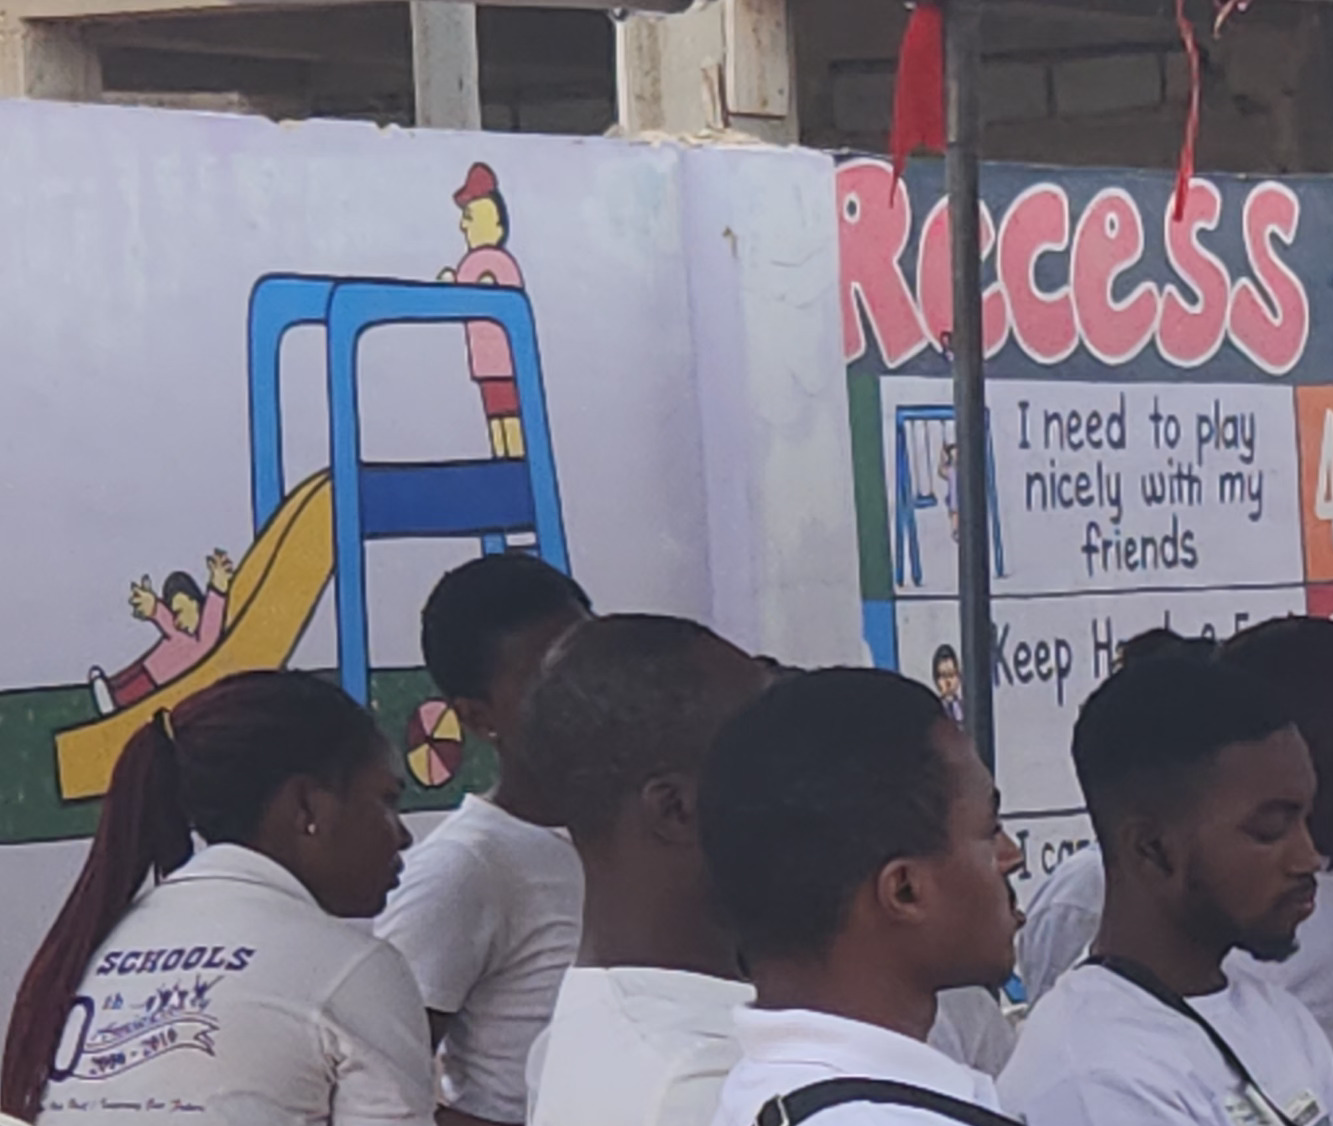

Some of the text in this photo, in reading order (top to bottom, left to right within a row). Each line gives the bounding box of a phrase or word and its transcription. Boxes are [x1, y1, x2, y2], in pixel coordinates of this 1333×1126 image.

[1018, 391, 1257, 467] I need to play
[1025, 456, 1264, 525] nicely with my
[1081, 512, 1200, 577] friends
[992, 620, 1073, 706] Keep
[96, 945, 258, 976] SCHOOLS
